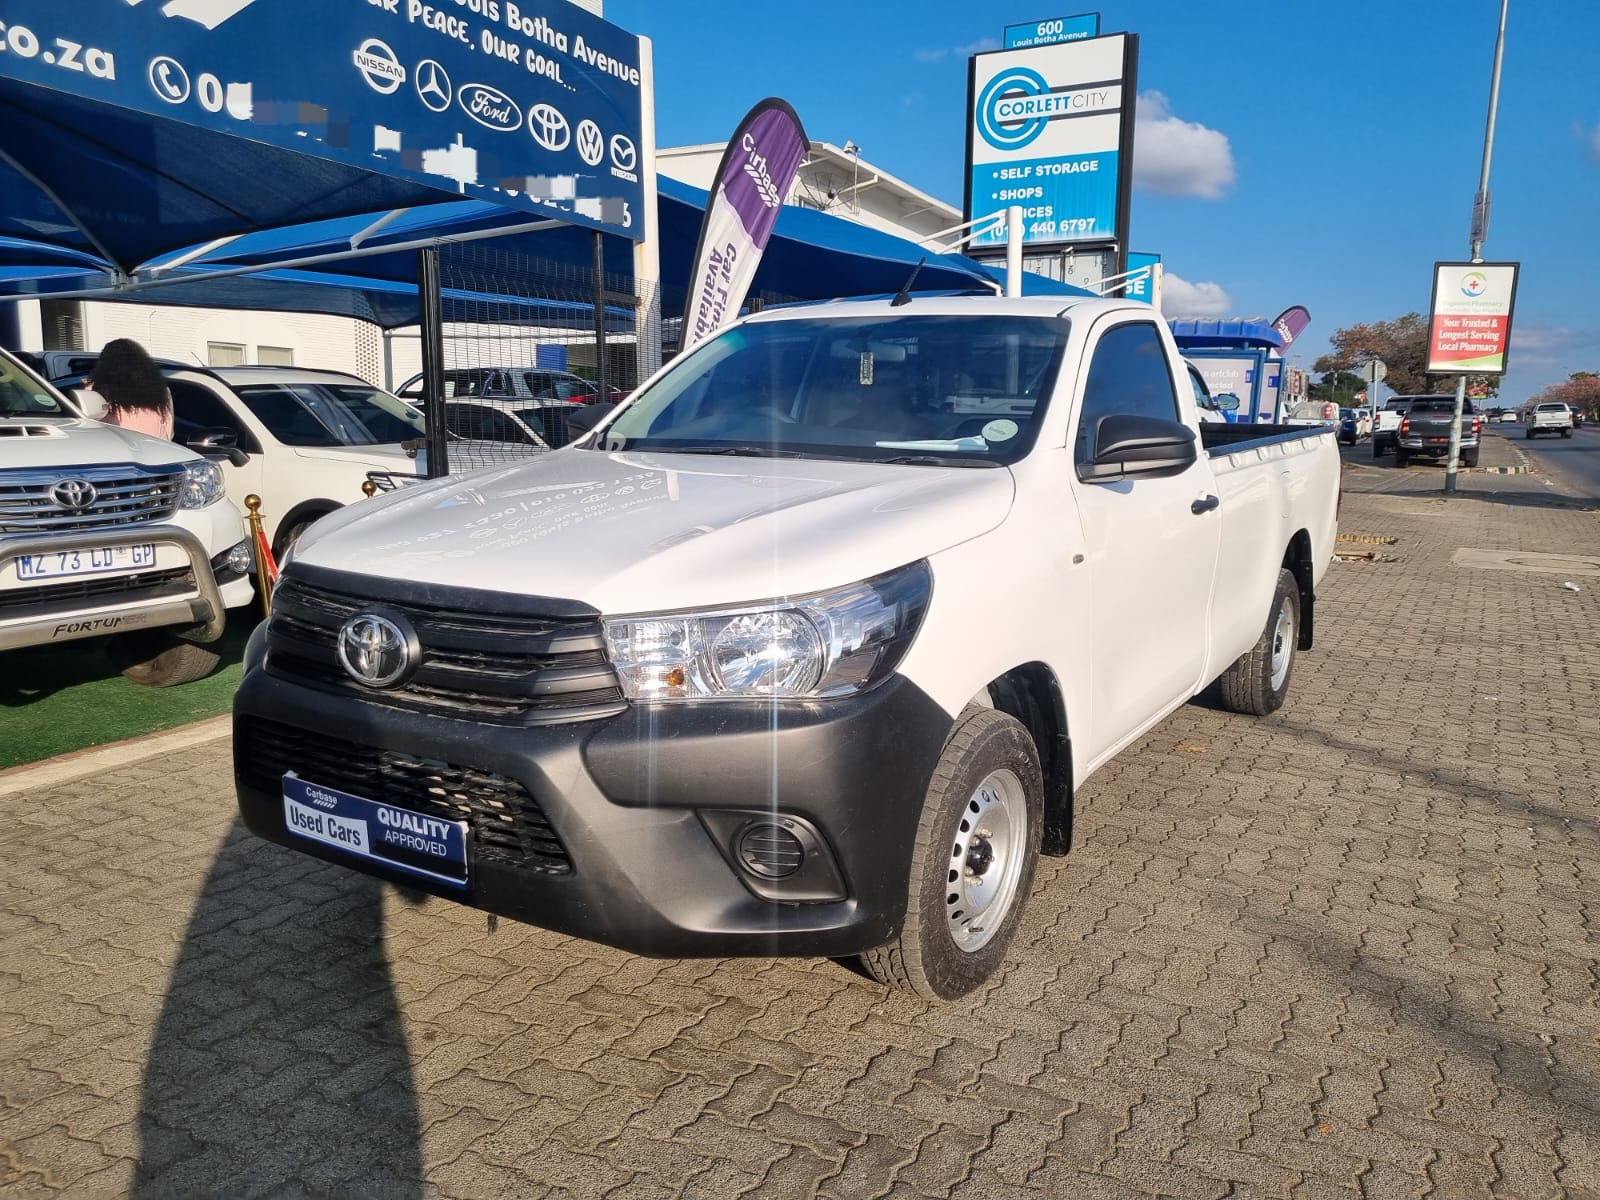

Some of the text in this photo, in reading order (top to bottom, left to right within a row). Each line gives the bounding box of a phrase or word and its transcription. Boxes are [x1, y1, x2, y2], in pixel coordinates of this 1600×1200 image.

[1012, 31, 1088, 47] Louis Botha Avenue
[1037, 20, 1064, 36] 600
[482, 29, 520, 64] OUR
[506, 1, 568, 53] Botha
[573, 35, 640, 86] Avenue
[357, 54, 403, 78] NISSAN
[471, 90, 511, 123] Ford
[1000, 160, 1099, 180] SELF STORAGE
[999, 186, 1043, 201] SHOPS
[1029, 220, 1056, 233] 440
[1060, 217, 1096, 232] 6797
[721, 243, 737, 284] Car
[1443, 318, 1498, 328] Your Trusted &
[1439, 330, 1500, 342] Longest Serving
[1438, 341, 1498, 354] Local Pharmacy
[58, 551, 80, 570] 73
[91, 548, 113, 568] LD
[132, 544, 151, 565] GP
[306, 786, 338, 805] Carbase
[290, 805, 362, 846] Used Cars
[377, 807, 450, 840] QUALITY
[385, 830, 447, 857] APPROVED
